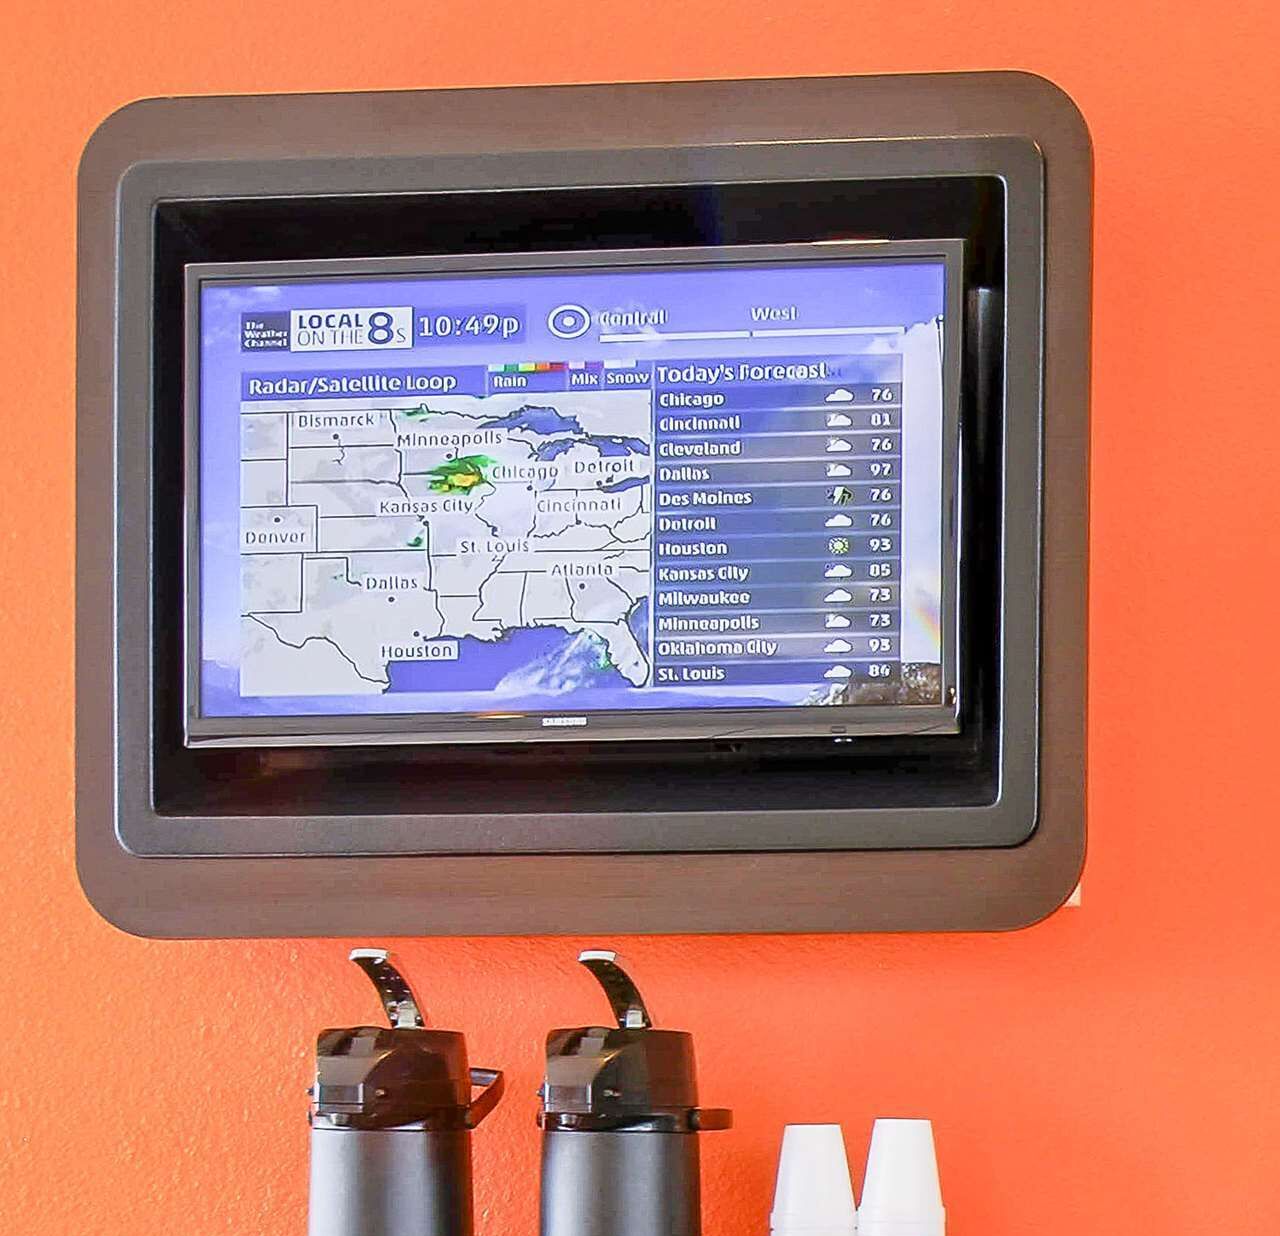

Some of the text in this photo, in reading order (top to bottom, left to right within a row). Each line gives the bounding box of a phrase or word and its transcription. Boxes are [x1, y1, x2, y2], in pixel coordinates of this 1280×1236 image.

[298, 314, 363, 329] LOCAL
[751, 307, 797, 321] West
[419, 314, 520, 337] 10:49p
[297, 329, 363, 346] ON THE
[493, 376, 528, 388] Rain
[606, 371, 649, 385] Snow
[657, 364, 733, 384] Today's
[249, 374, 456, 395] Radar/Satellite Loop
[660, 389, 893, 408] Chicago 76
[298, 413, 374, 426] Bismarck
[660, 415, 741, 431] Cincinnati
[397, 431, 502, 448] Minneapolis
[660, 438, 893, 457] Cleveland 76
[492, 465, 558, 482] Chicago
[574, 460, 634, 474] Detroit
[660, 463, 892, 481] Dallas 97
[537, 498, 621, 512] Cincinnati
[659, 488, 892, 506] Des Moines 76
[380, 500, 473, 516] Kansas City
[659, 513, 892, 531] Detroit 76
[245, 531, 306, 544] Denver
[487, 540, 529, 553] Louis
[659, 539, 891, 556] Houston 93
[551, 563, 613, 576] Atlanta
[659, 565, 749, 583] Kansas City
[366, 576, 418, 590] Dallas
[659, 588, 891, 605] Milwaukee 73
[659, 614, 891, 634] Minneapolis 73
[381, 644, 452, 658] Houston
[659, 639, 778, 657] Oklahoma City
[659, 667, 725, 681] St. Louis
